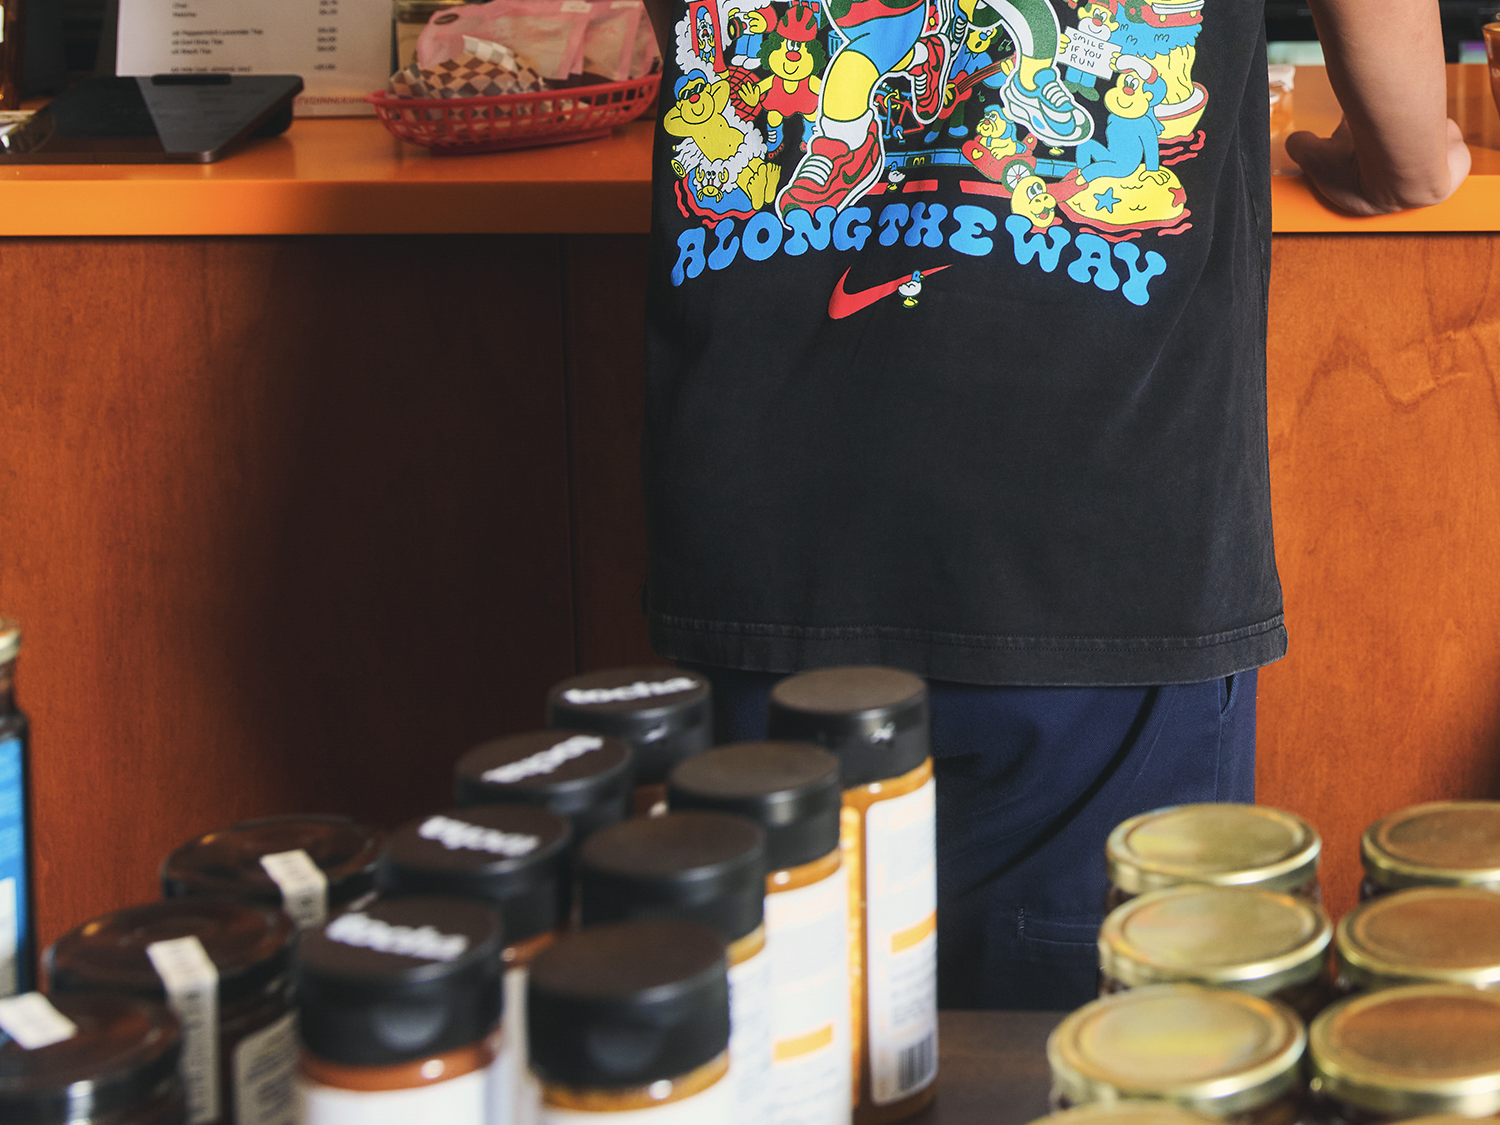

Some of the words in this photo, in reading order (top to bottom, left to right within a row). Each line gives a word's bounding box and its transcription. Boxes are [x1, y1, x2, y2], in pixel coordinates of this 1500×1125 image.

[1072, 32, 1105, 51] SMILE
[1070, 44, 1080, 53] IF
[1083, 48, 1102, 60] YOU
[1070, 53, 1095, 68] RUN
[670, 205, 873, 287] ALONG
[878, 201, 997, 257] THE
[1004, 213, 1168, 307] WAY
